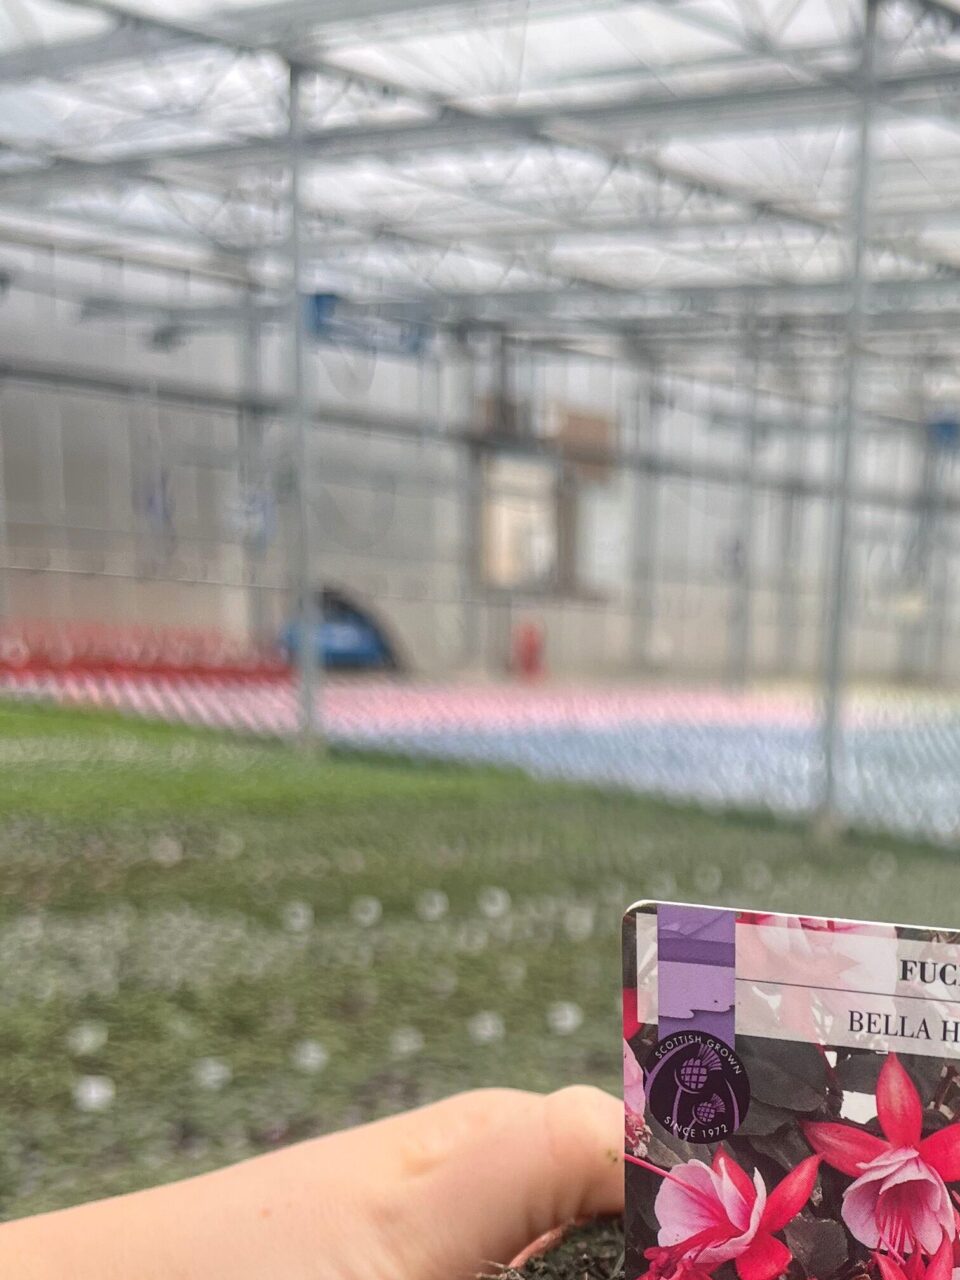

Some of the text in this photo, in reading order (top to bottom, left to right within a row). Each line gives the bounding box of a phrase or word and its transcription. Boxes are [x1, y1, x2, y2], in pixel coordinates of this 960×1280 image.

[848, 1010, 931, 1040] BELLA
[655, 1035, 742, 1075] SCOTTISH GROWN
[664, 1116, 728, 1138] SINCE 1972
